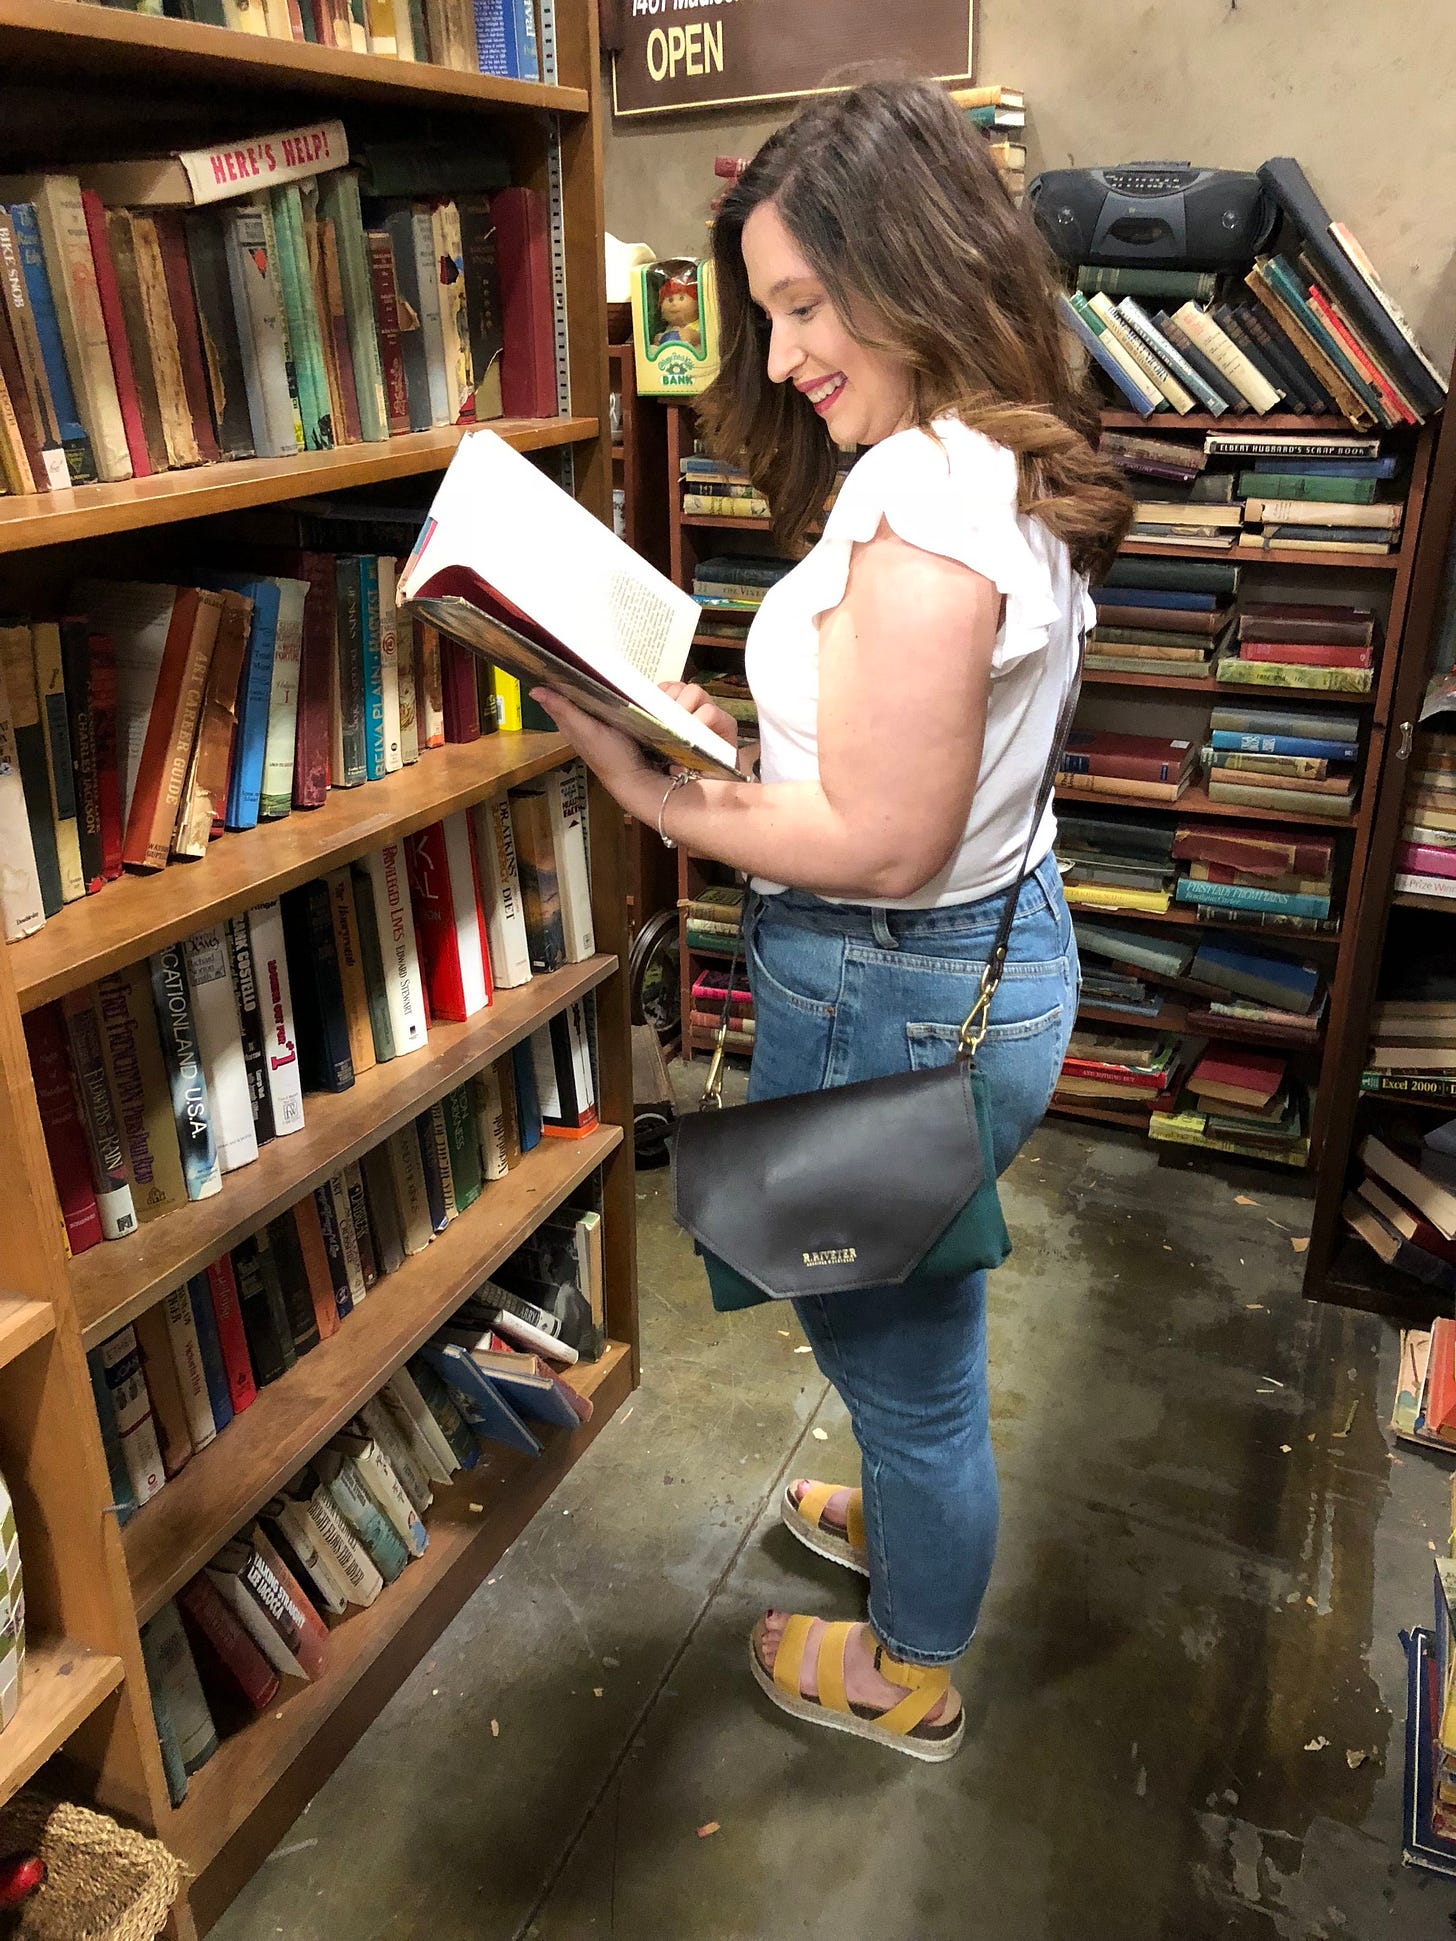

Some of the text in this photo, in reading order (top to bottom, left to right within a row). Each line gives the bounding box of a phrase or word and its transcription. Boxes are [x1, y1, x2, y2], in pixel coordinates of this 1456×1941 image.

[647, 20, 724, 82] OPEN
[210, 131, 331, 185] HERE'S HELP!
[0, 227, 25, 308] BIKE SNOB
[662, 375, 694, 386] BANK
[1219, 443, 1250, 452] ELBERT
[1252, 444, 1303, 455] HUBBARD'S
[1305, 446, 1335, 455] SCRAP
[371, 665, 384, 719] PLAIN
[177, 689, 201, 752] CAREER
[77, 712, 97, 835] CHARLES JACKSON
[374, 723, 386, 777] BELVA
[166, 757, 187, 805] GUIDE
[502, 887, 516, 920] DIET
[1409, 879, 1433, 890] Prize
[391, 908, 406, 943] LIVES
[236, 950, 257, 1012] COSTELLO
[396, 944, 410, 979] EDWARD
[399, 979, 414, 1016] STEWART
[160, 944, 208, 1139] ACATIONLAND U.S.A.
[1382, 1078, 1408, 1090] Excel
[1411, 1080, 1438, 1092] 2000
[98, 1132, 124, 1171] RAIN
[247, 1565, 285, 1621] LEE IACOCCA
